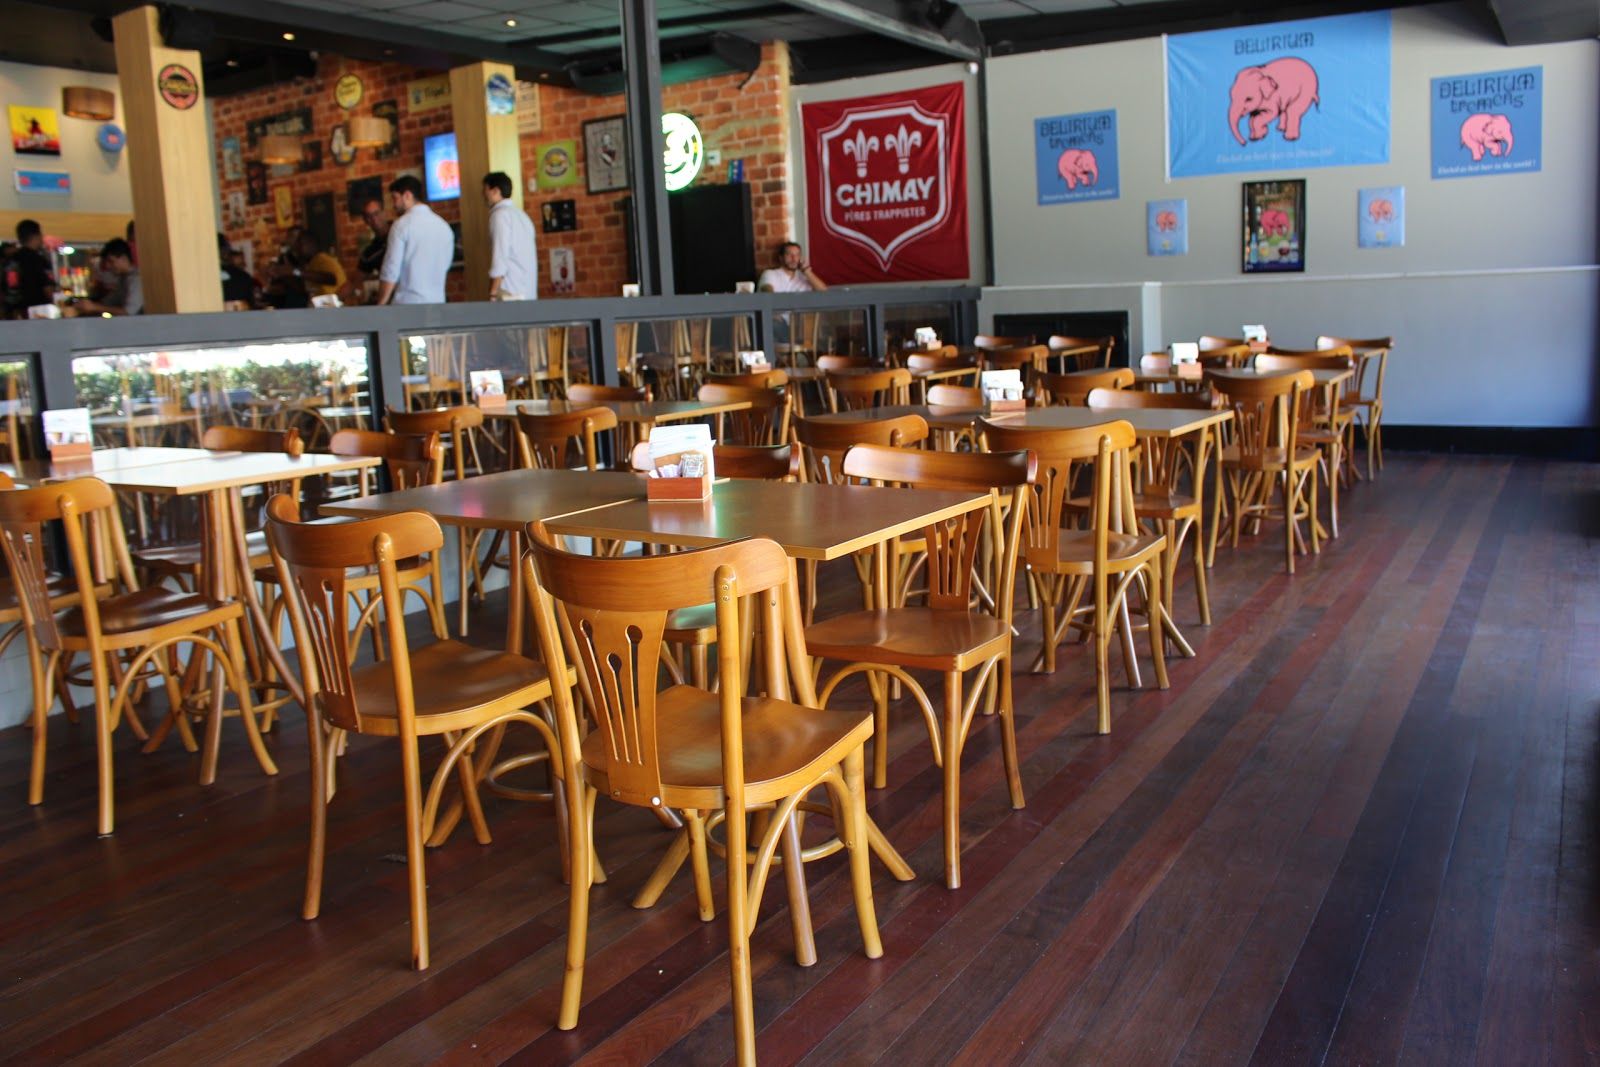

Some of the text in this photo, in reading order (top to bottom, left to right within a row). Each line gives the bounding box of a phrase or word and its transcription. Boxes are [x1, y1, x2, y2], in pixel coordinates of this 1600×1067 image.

[1234, 31, 1315, 56] DELIRIUM
[1440, 72, 1535, 99] DELIRIUM
[1040, 114, 1112, 137] DELIRIUM
[836, 176, 935, 207] CHIMAY
